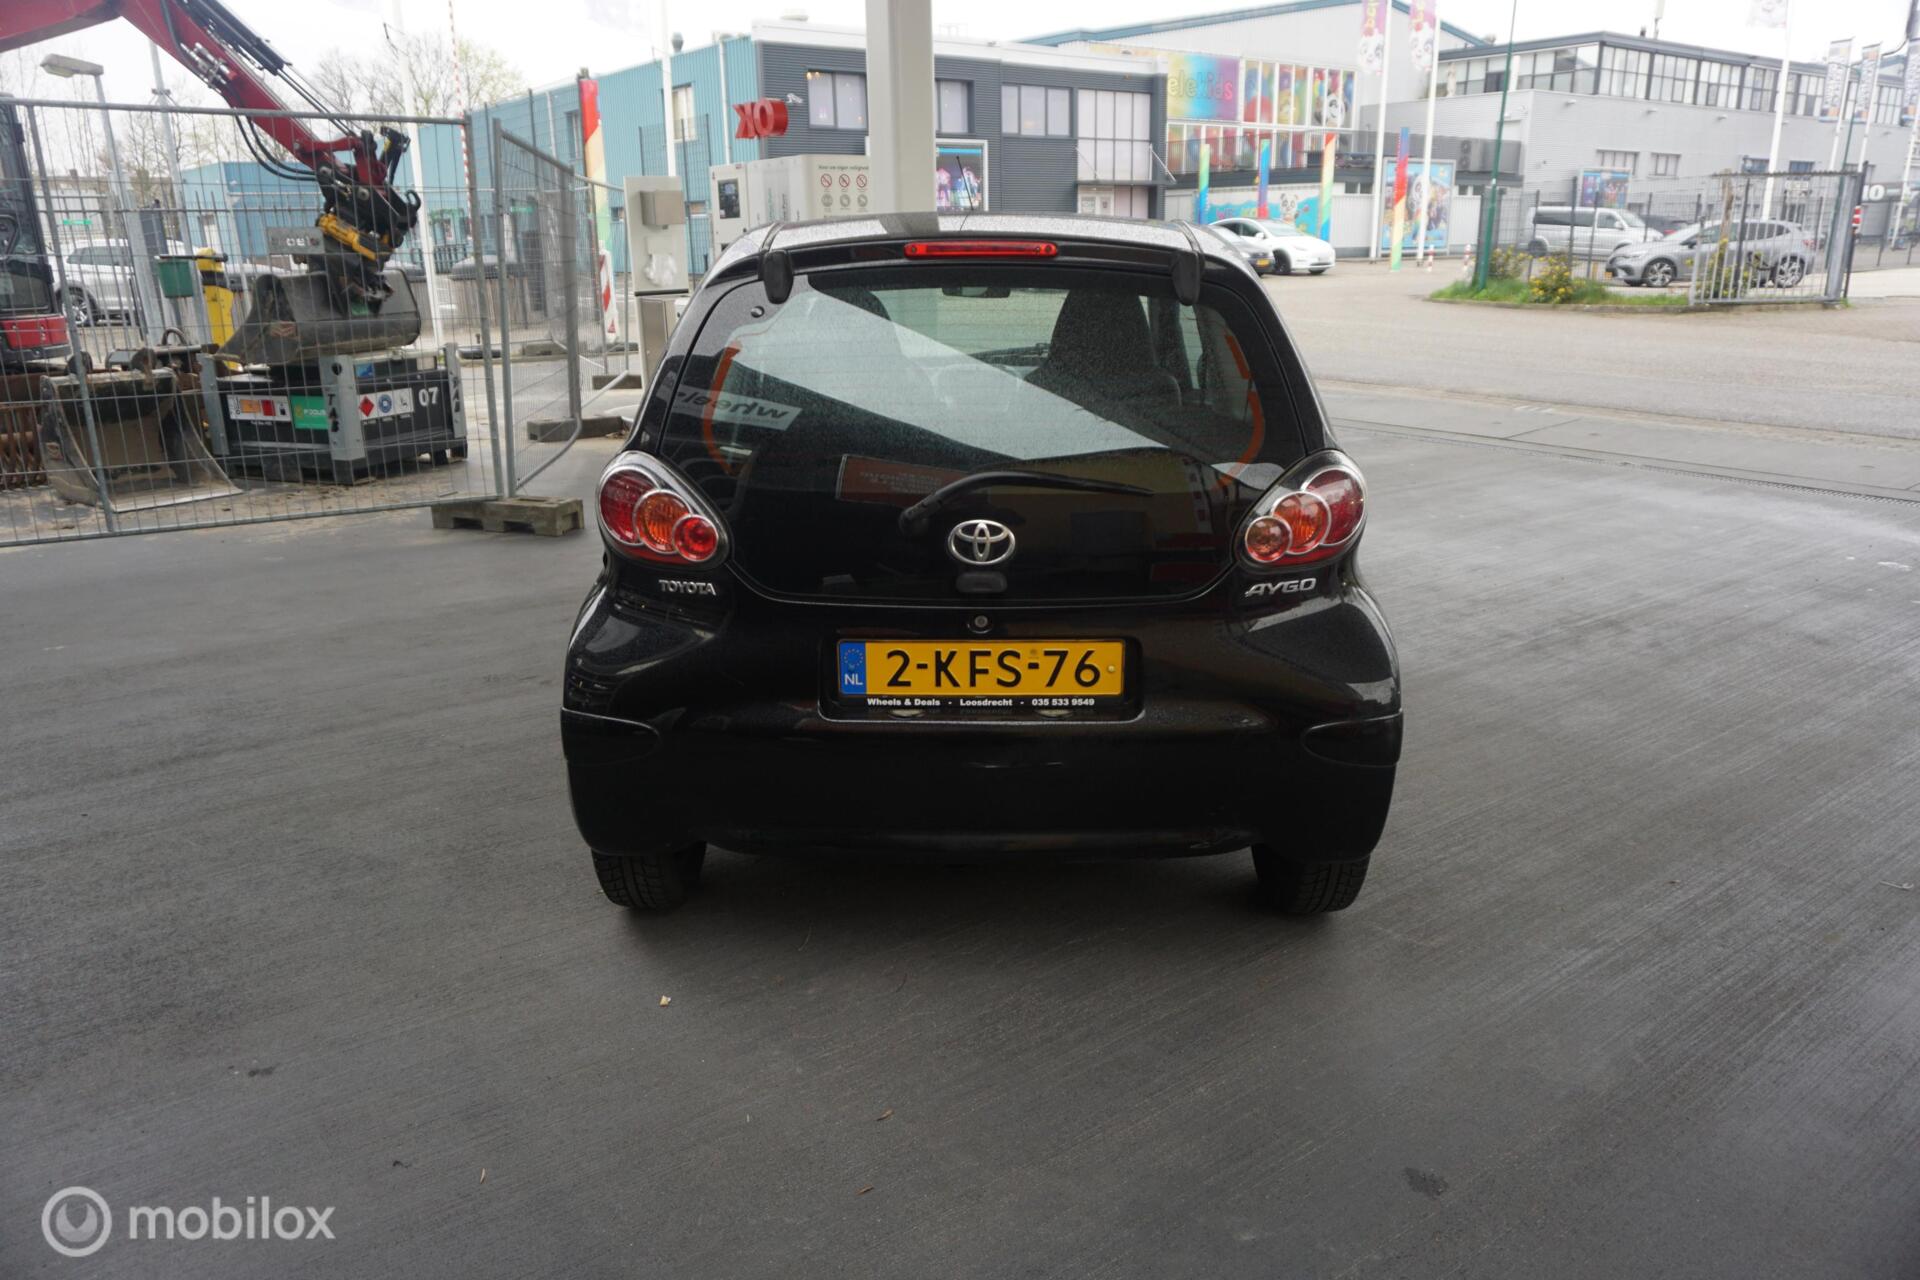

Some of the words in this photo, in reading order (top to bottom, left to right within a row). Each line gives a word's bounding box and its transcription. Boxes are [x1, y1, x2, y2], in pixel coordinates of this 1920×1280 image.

[418, 387, 439, 407] 07
[658, 579, 717, 596] TOYOTA
[1244, 577, 1317, 598] AYGO
[886, 649, 1101, 688] 2-KFS-76
[844, 673, 864, 686] NL
[867, 698, 901, 706] Wheels
[904, 698, 912, 706] &
[914, 698, 940, 706] Deals
[960, 698, 1012, 706] Loosdrecht
[1032, 698, 1049, 706] 035
[1051, 698, 1069, 706] 533
[1071, 698, 1095, 706] 9549
